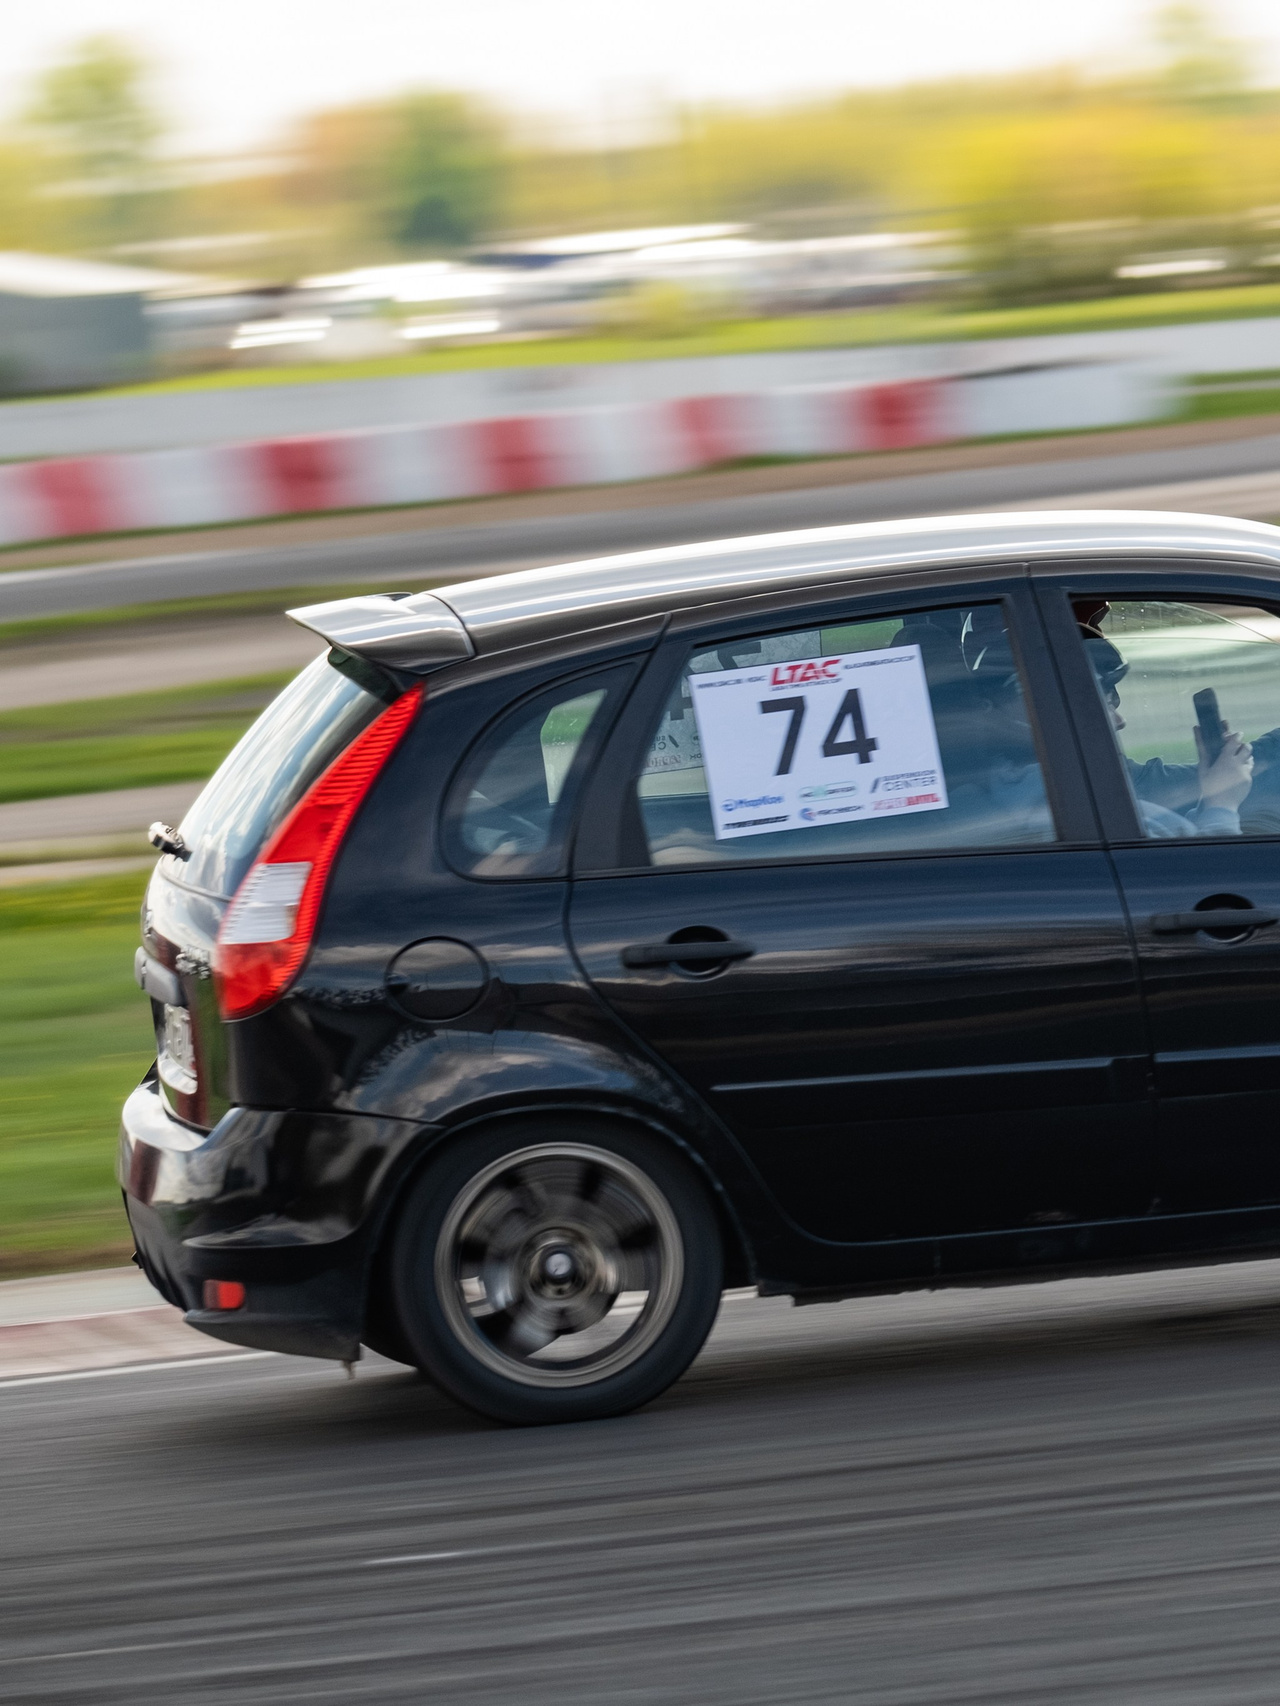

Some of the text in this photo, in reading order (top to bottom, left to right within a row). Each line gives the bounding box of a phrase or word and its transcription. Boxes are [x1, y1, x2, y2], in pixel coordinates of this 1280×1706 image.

[771, 659, 841, 685] LTAC
[759, 688, 878, 776] 74
[882, 776, 937, 791] CENTER
